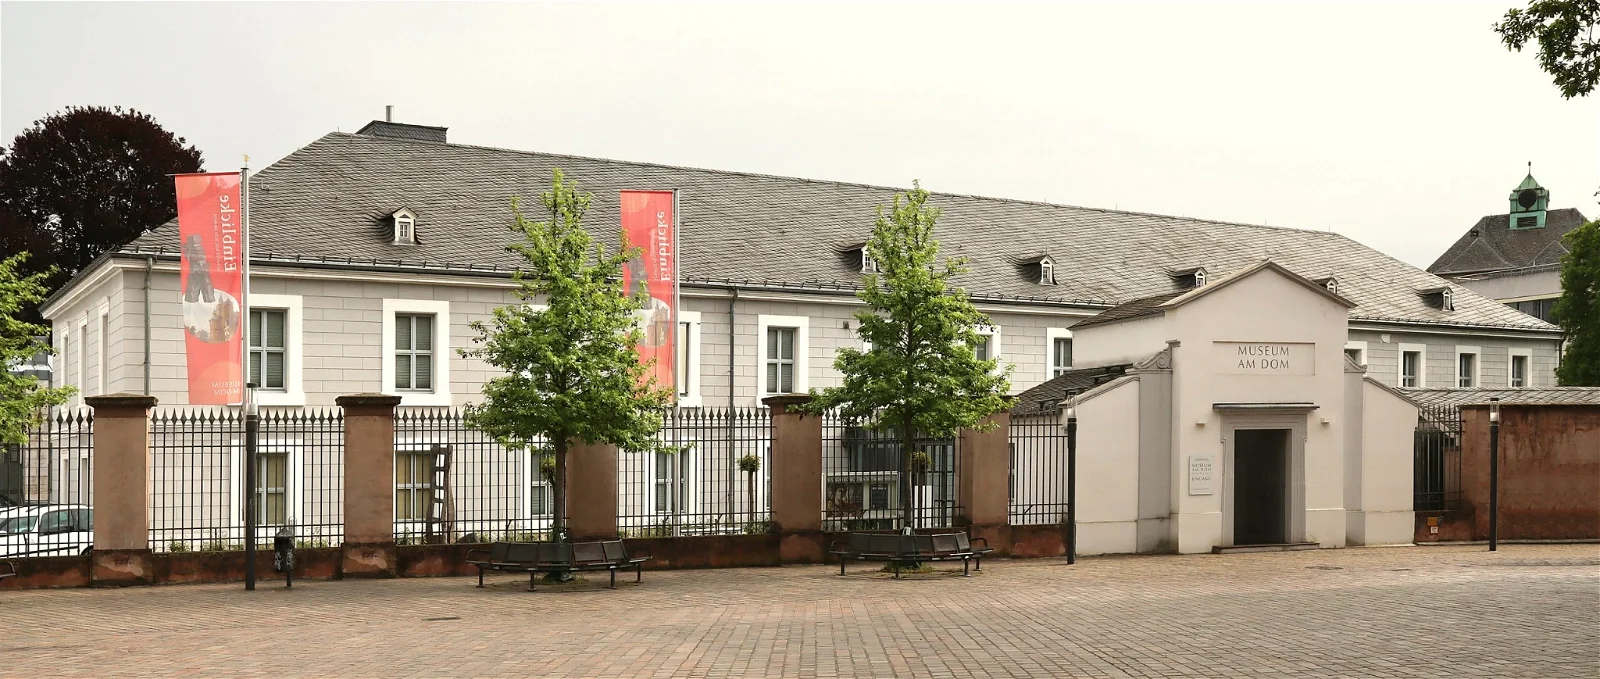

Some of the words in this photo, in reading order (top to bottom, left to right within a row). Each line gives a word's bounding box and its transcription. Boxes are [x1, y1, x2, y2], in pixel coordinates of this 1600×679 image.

[1237, 345, 1290, 356] MUSEUM
[1237, 359, 1256, 369] AM
[1261, 359, 1290, 370] DOM
